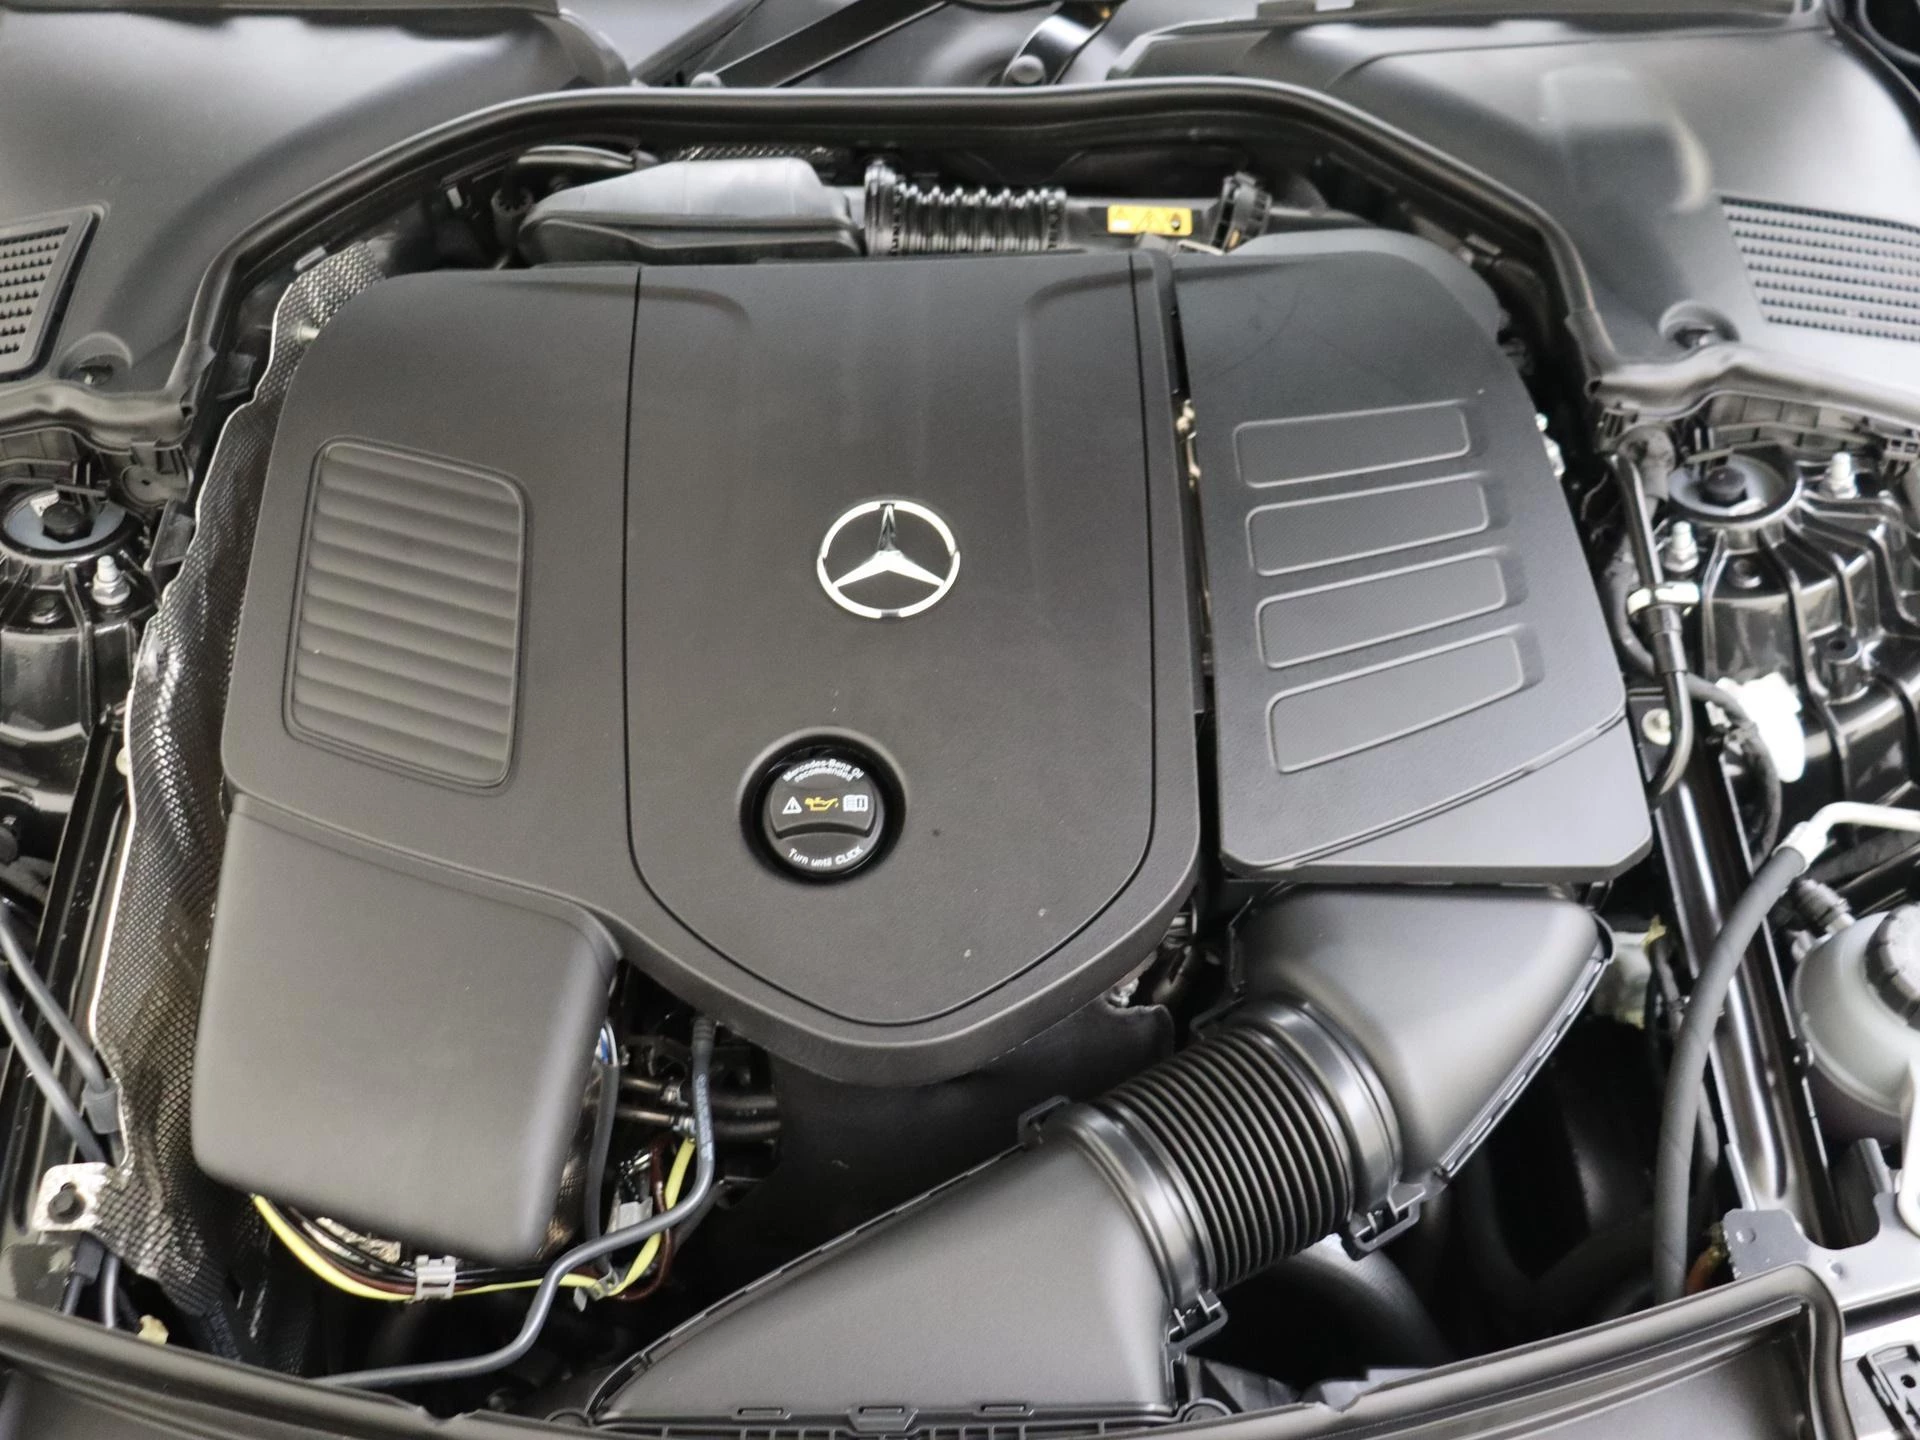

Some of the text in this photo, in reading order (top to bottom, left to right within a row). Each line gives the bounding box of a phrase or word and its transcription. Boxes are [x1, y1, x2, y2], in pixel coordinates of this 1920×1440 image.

[794, 767, 853, 783] recommended
[788, 845, 864, 867] Turn until CLICK
